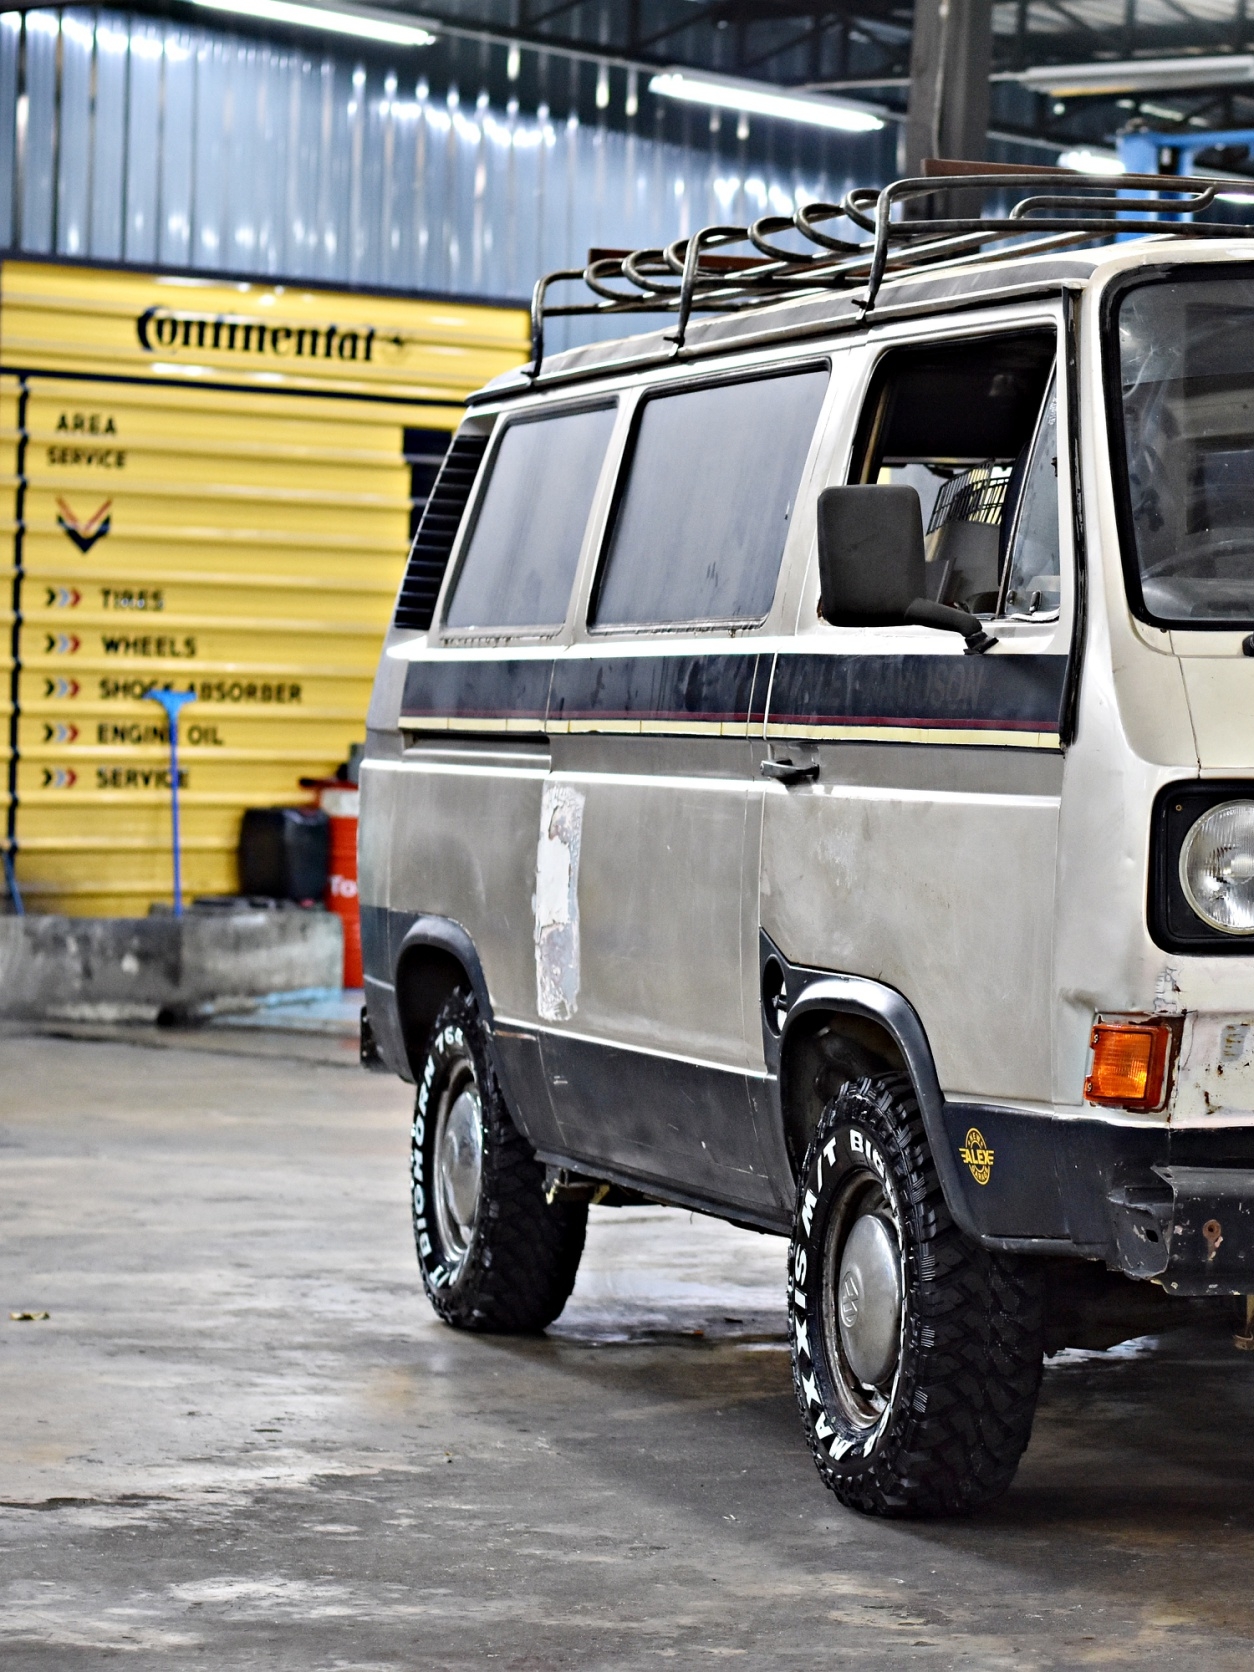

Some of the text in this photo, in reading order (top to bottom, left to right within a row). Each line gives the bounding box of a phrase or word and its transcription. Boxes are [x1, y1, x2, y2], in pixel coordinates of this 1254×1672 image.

[136, 306, 377, 362] Continental
[56, 414, 117, 435] AREA
[47, 446, 127, 469] SERVICE
[101, 587, 163, 612] TIRES
[102, 634, 197, 659] WHEELS
[98, 724, 224, 746] ENGIN OIL
[413, 1055, 435, 1257] BIGHORN
[435, 1025, 464, 1054] 764
[801, 1137, 837, 1239] M/T
[793, 1244, 854, 1461] MAXXIS
